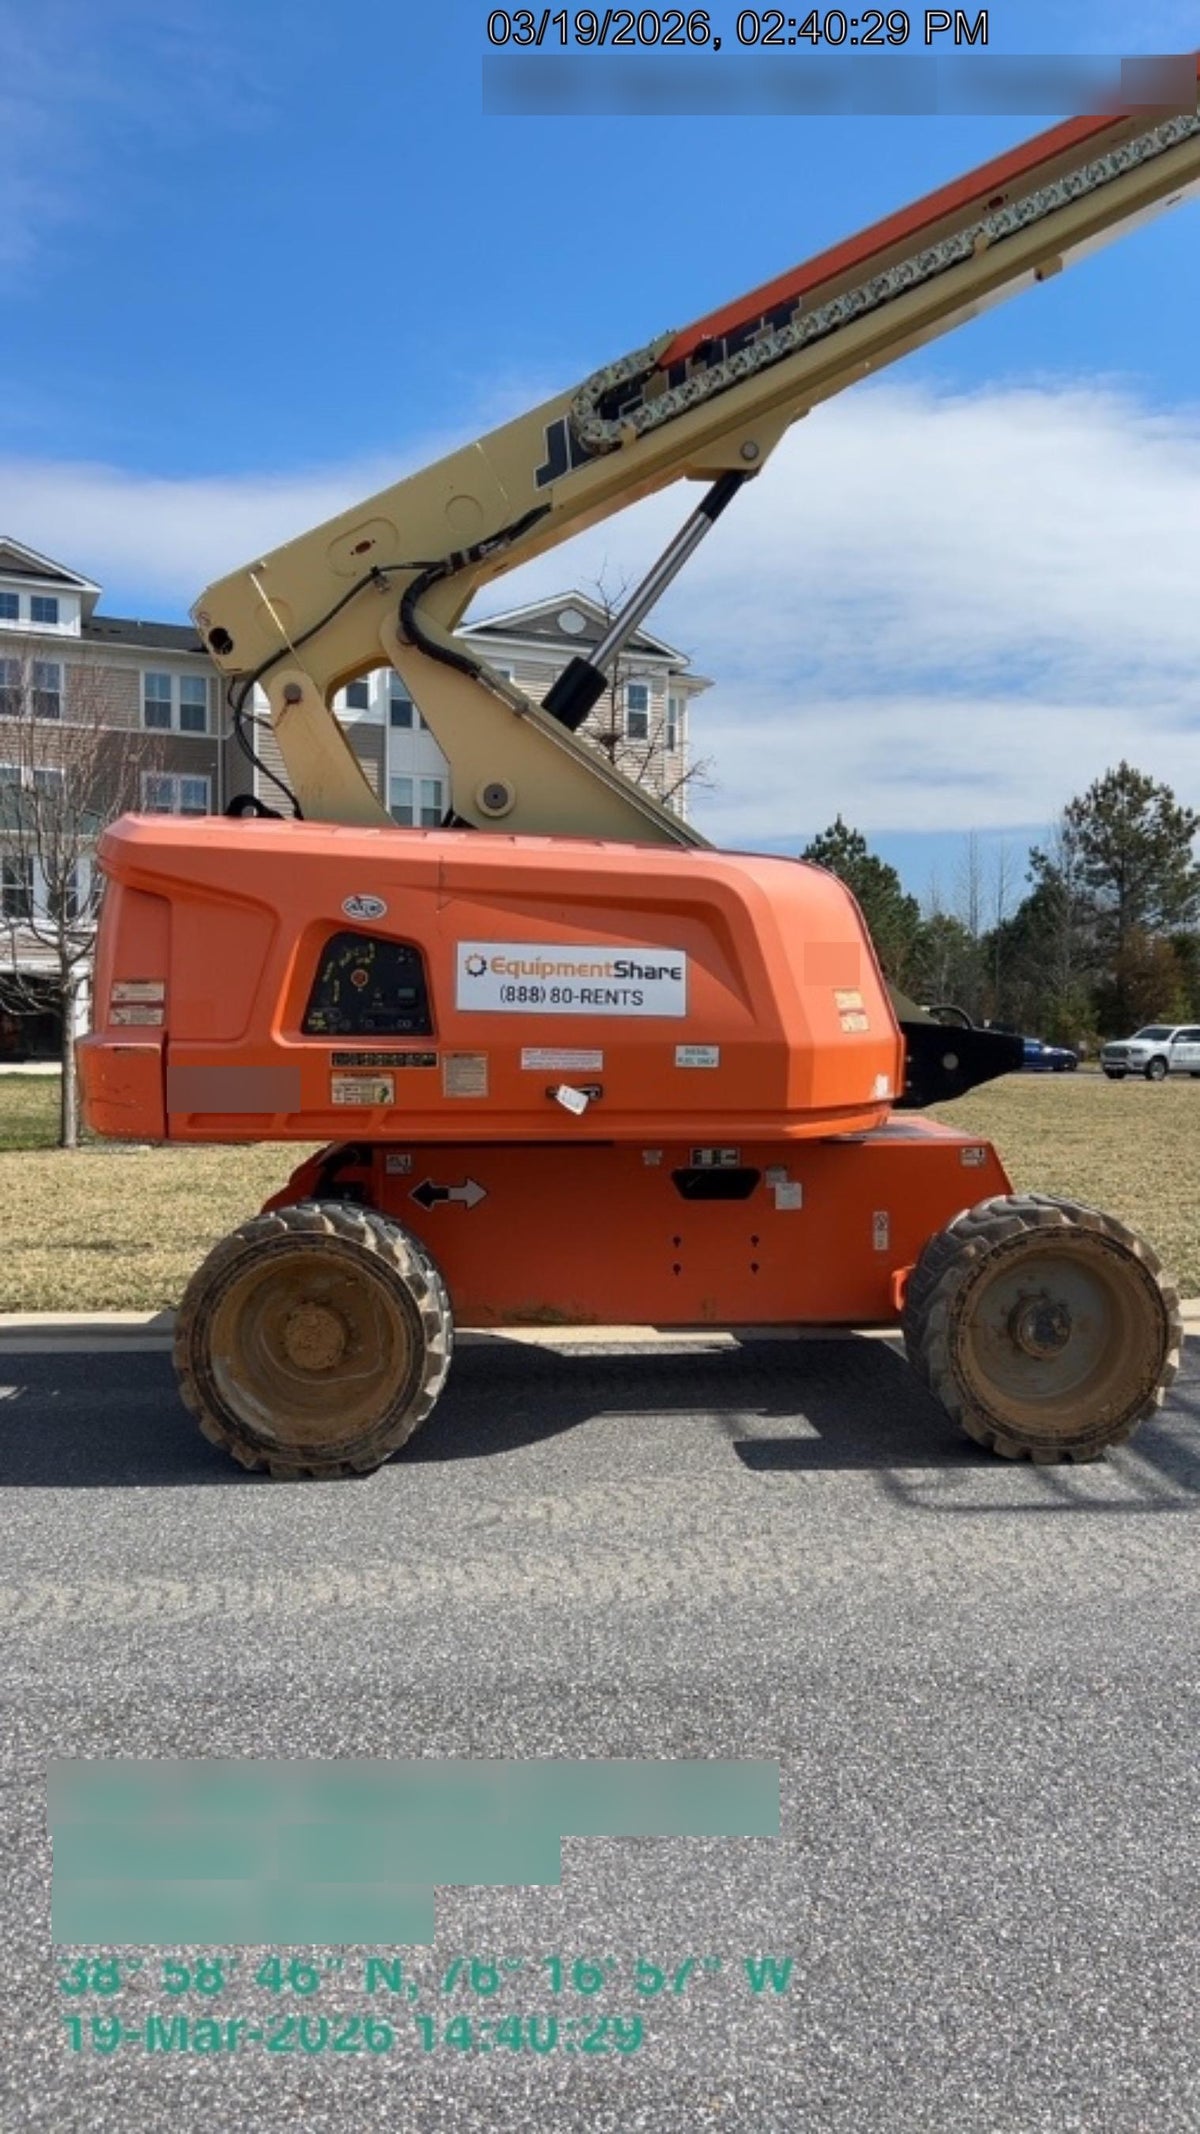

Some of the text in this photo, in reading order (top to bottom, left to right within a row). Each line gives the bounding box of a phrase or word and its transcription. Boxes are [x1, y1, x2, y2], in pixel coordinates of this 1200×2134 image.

[491, 956, 682, 981] EquipmentShare
[500, 985, 644, 1007] (888) 80-RENTS
